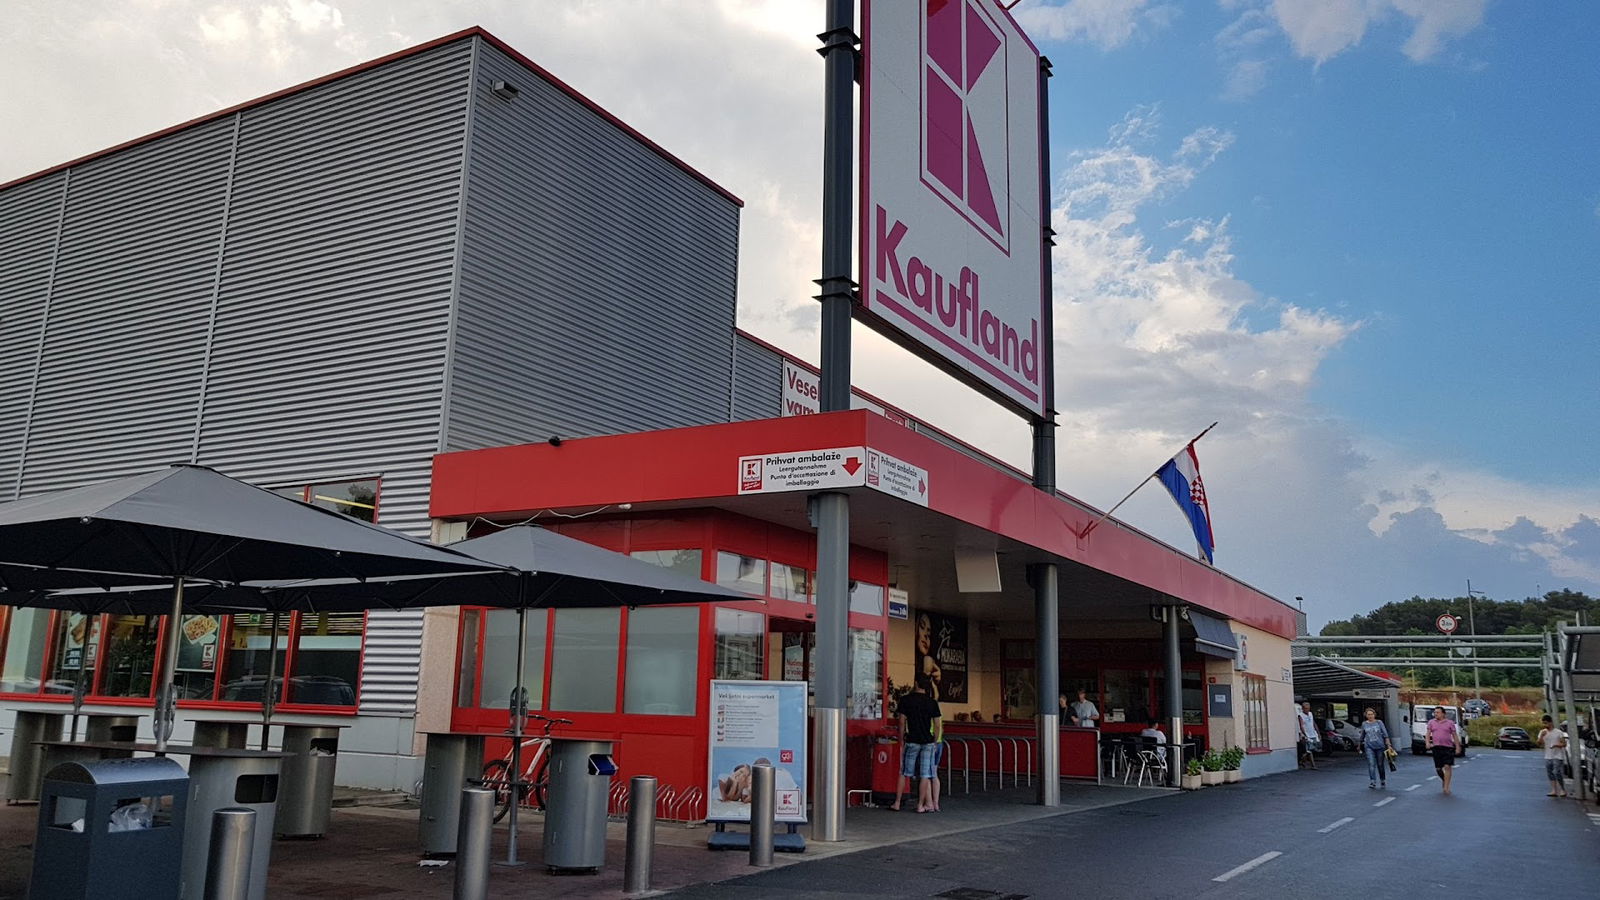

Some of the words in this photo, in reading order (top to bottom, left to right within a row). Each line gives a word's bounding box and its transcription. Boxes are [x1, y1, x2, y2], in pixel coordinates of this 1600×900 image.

[876, 203, 1039, 387] Kaufland
[766, 456, 796, 466] Prihvat
[797, 452, 841, 464] ambalaže
